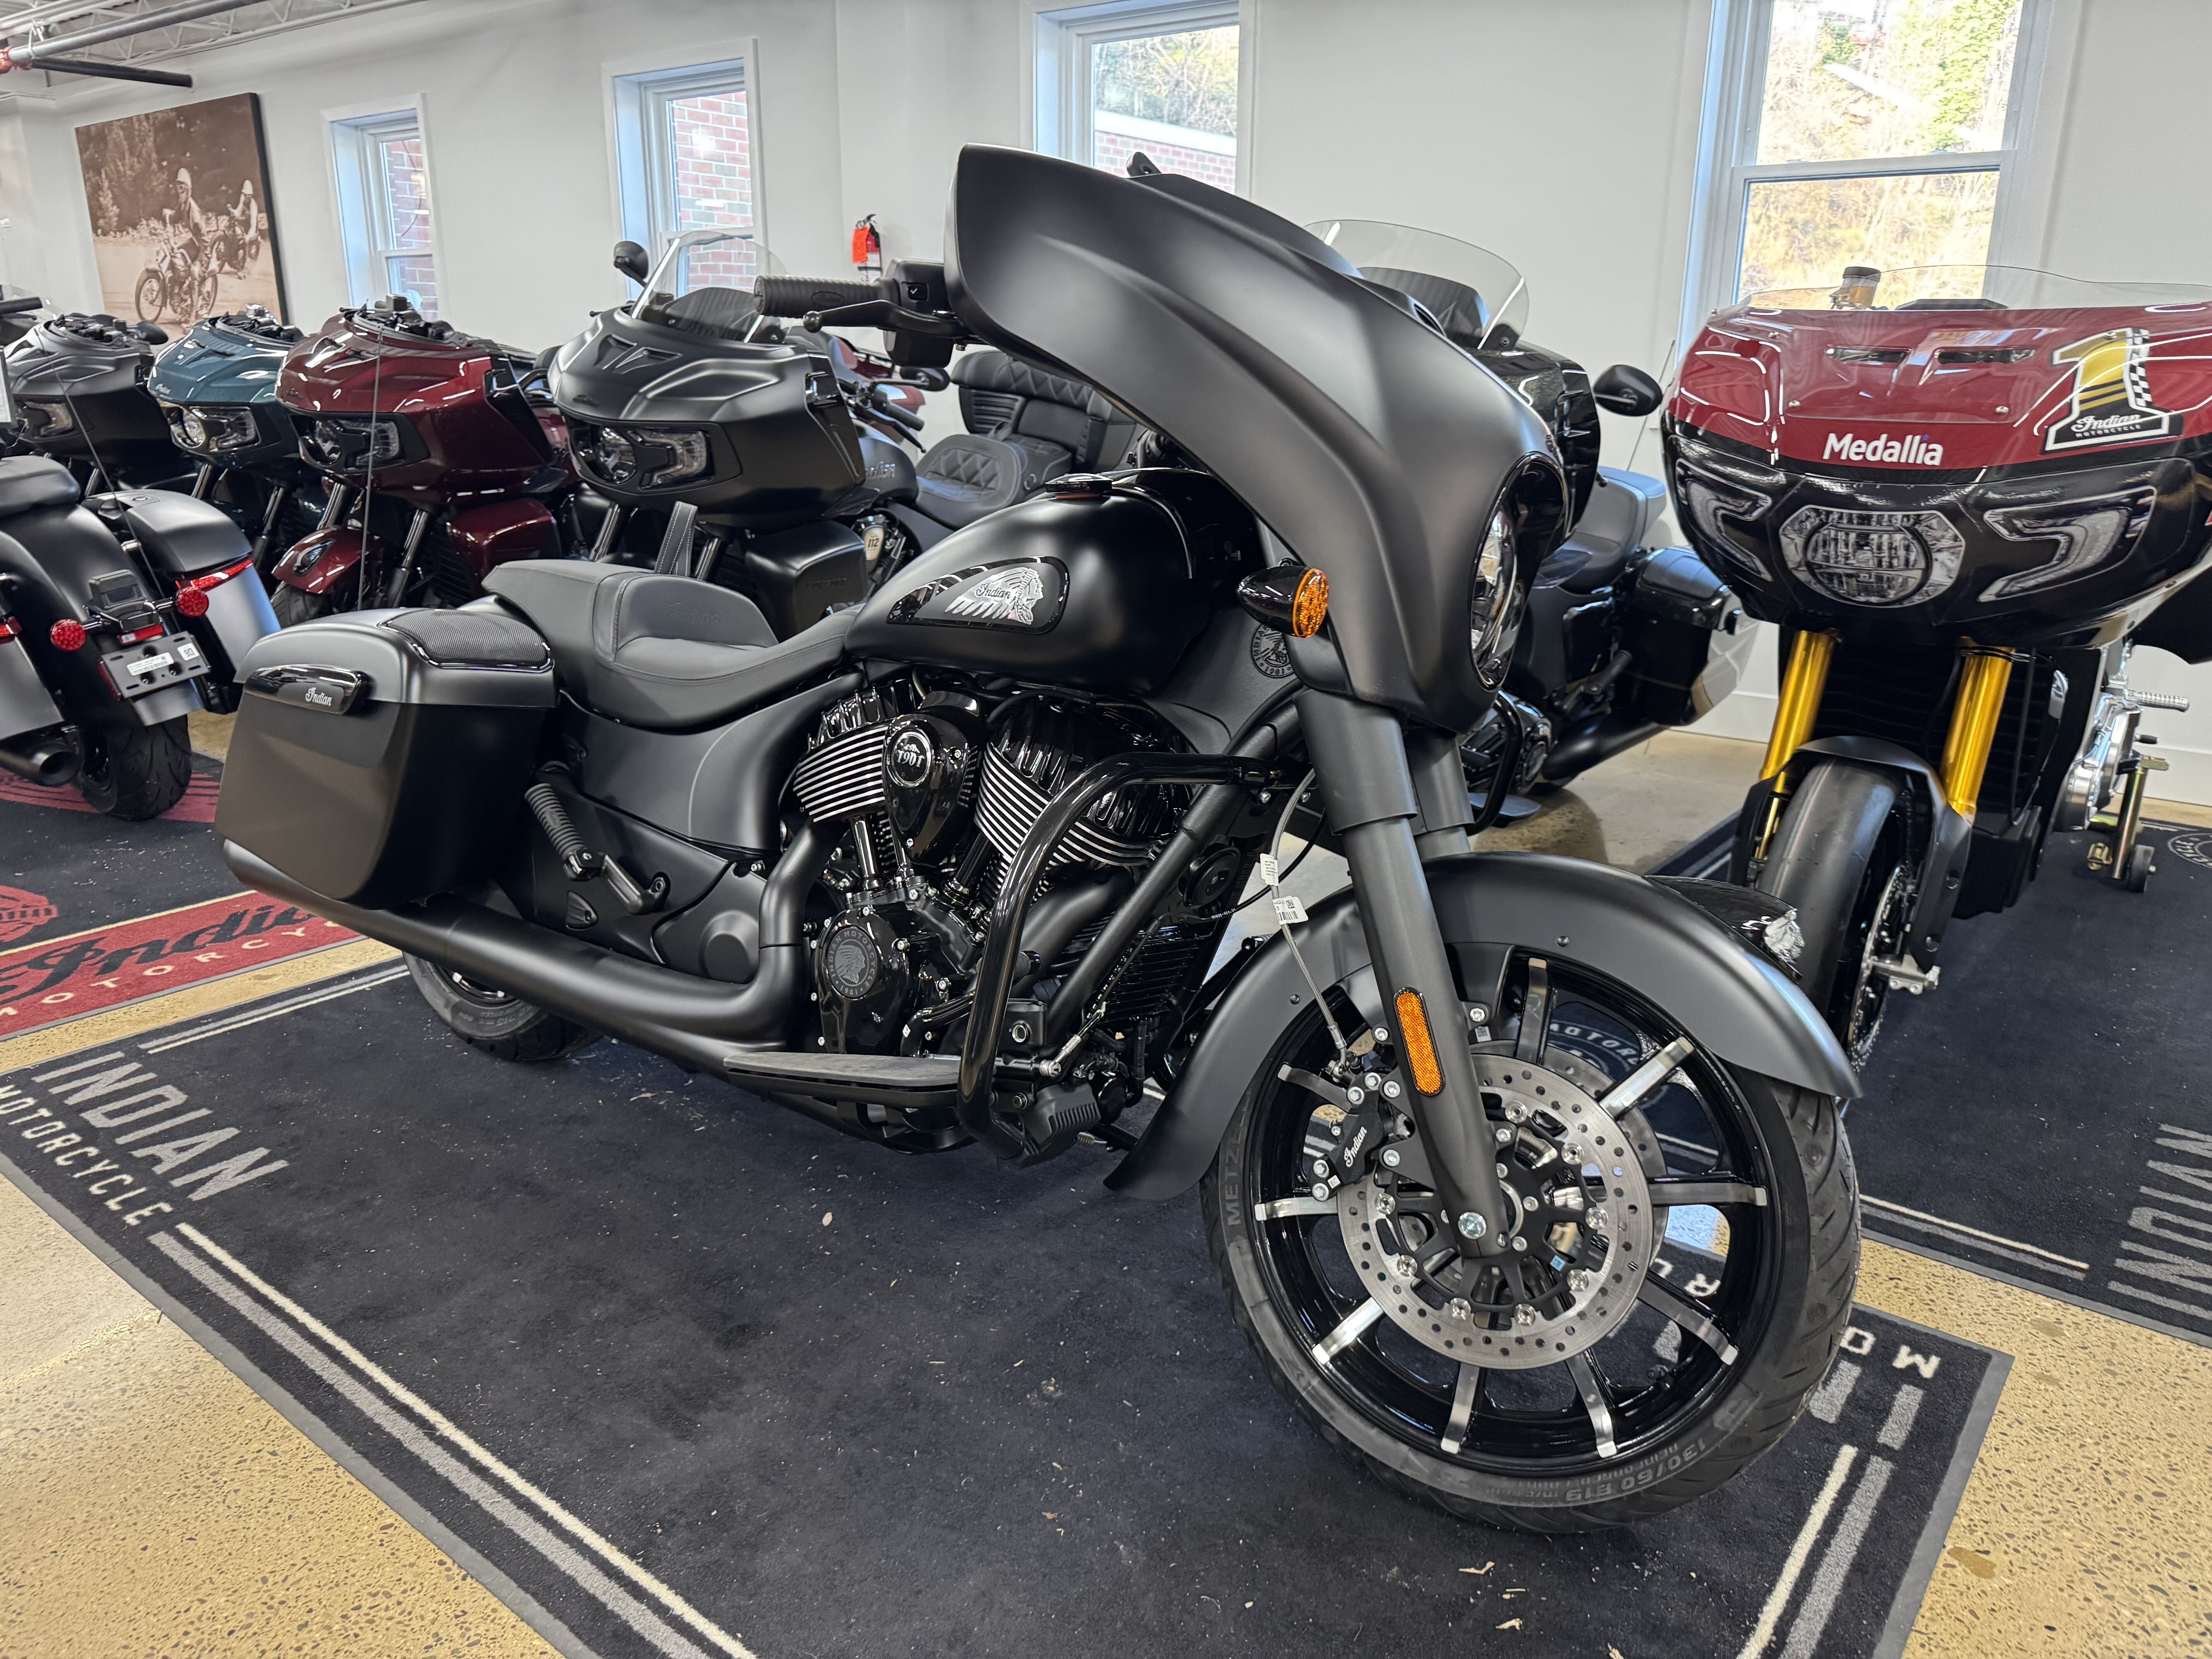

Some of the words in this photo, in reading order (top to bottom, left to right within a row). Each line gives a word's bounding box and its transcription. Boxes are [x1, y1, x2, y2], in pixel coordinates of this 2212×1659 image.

[2070, 414, 2142, 432] Indian
[1822, 433, 1944, 466] Medallia
[868, 538, 879, 548] 112
[976, 582, 1011, 599] Indian
[305, 687, 332, 706] Indian
[829, 936, 842, 977] INDIAN
[843, 930, 876, 988] MOTORCYCLE
[840, 985, 858, 995] 1901
[31, 1051, 289, 1201] INDIAN
[1344, 1126, 1367, 1168] Indian
[1621, 1437, 1706, 1490] 130/60
